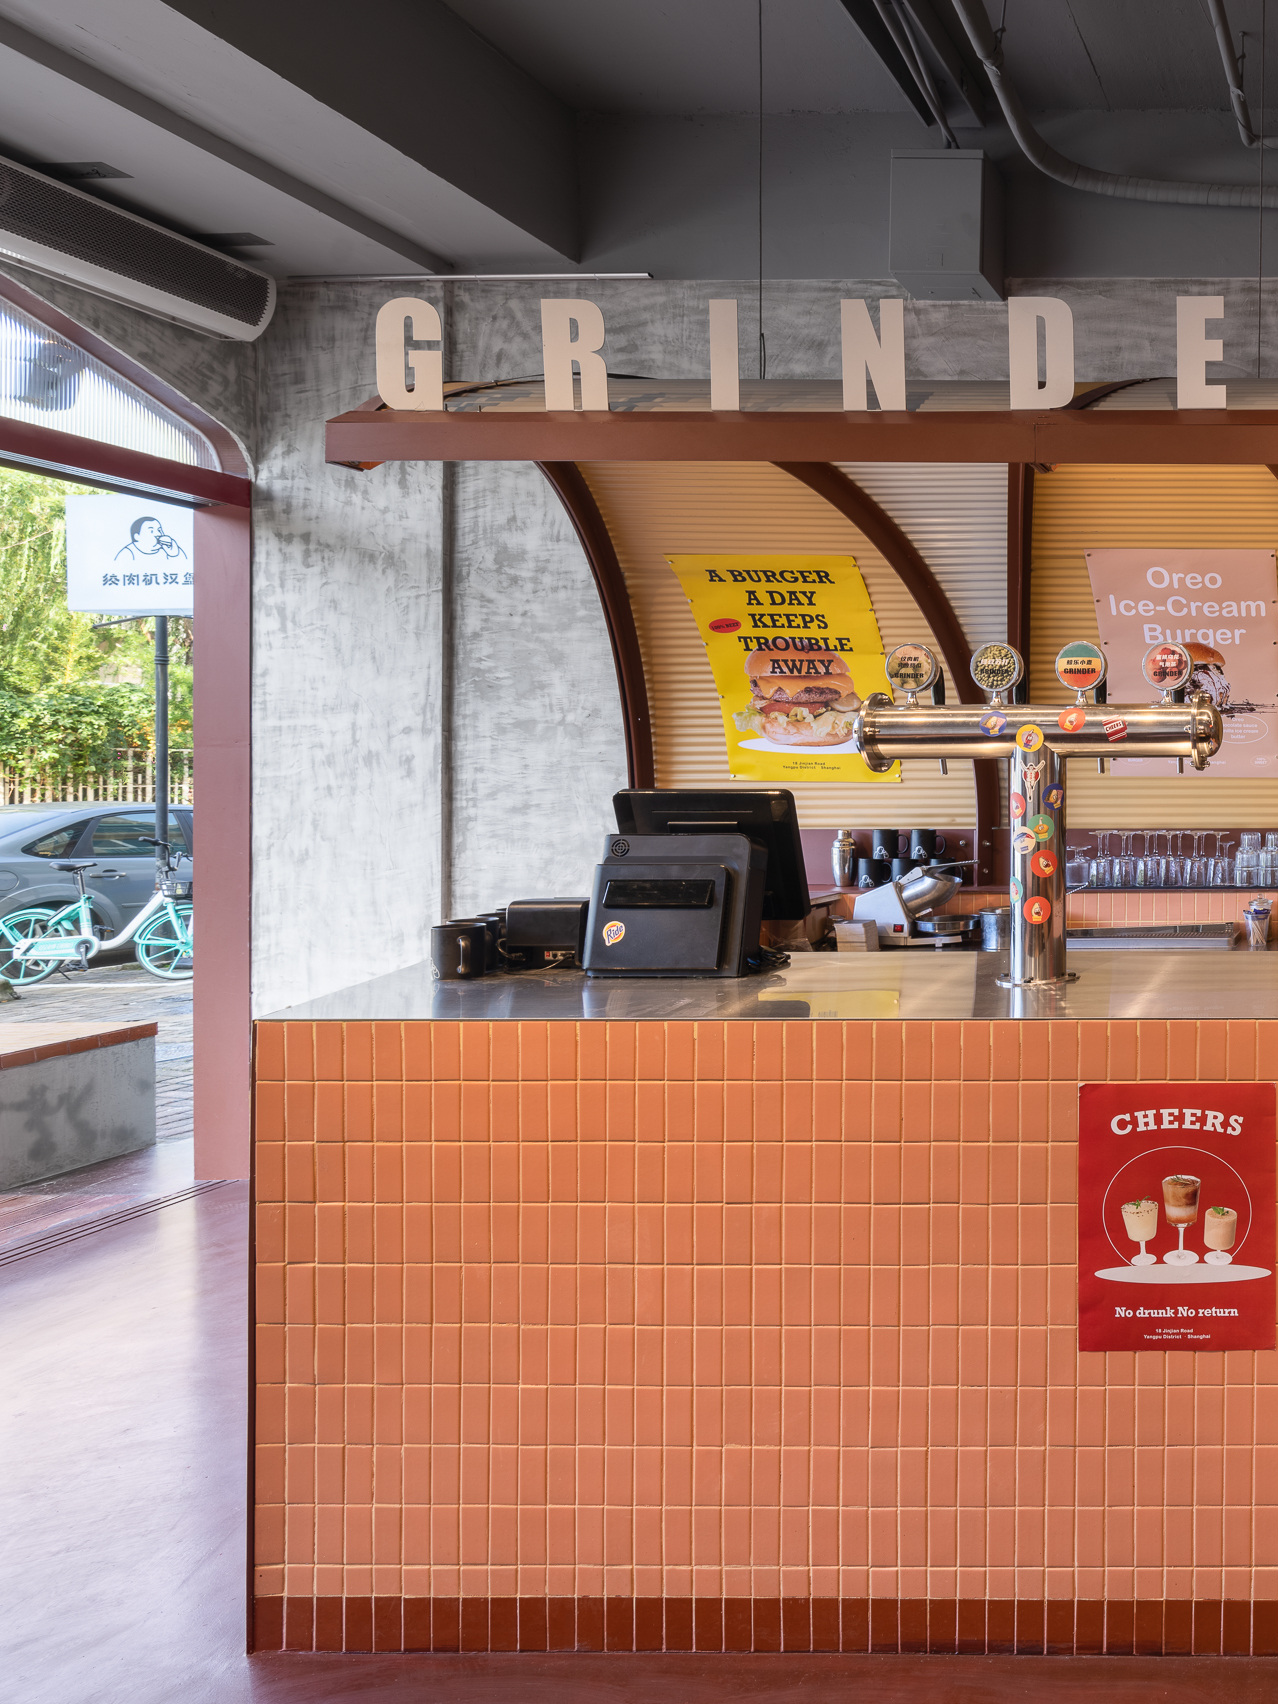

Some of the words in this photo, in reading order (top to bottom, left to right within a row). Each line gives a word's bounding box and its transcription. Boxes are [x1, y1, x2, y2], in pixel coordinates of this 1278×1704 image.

[705, 569, 724, 582] A
[726, 569, 836, 584] BURGER
[1146, 566, 1222, 589] Oreo
[745, 590, 764, 606] A
[765, 590, 816, 606] DAY
[1109, 594, 1266, 617] Ice-Cream
[748, 613, 829, 629] KEEPS
[1143, 623, 1247, 647] Burger
[738, 636, 853, 652] TROUBLE
[769, 659, 834, 675] AWAY
[606, 925, 624, 944] Ride
[1110, 1108, 1244, 1136] CHEERS
[1114, 1307, 1133, 1318] No
[1136, 1306, 1175, 1318] drunk
[1177, 1306, 1196, 1318] No
[1198, 1307, 1239, 1317] return
